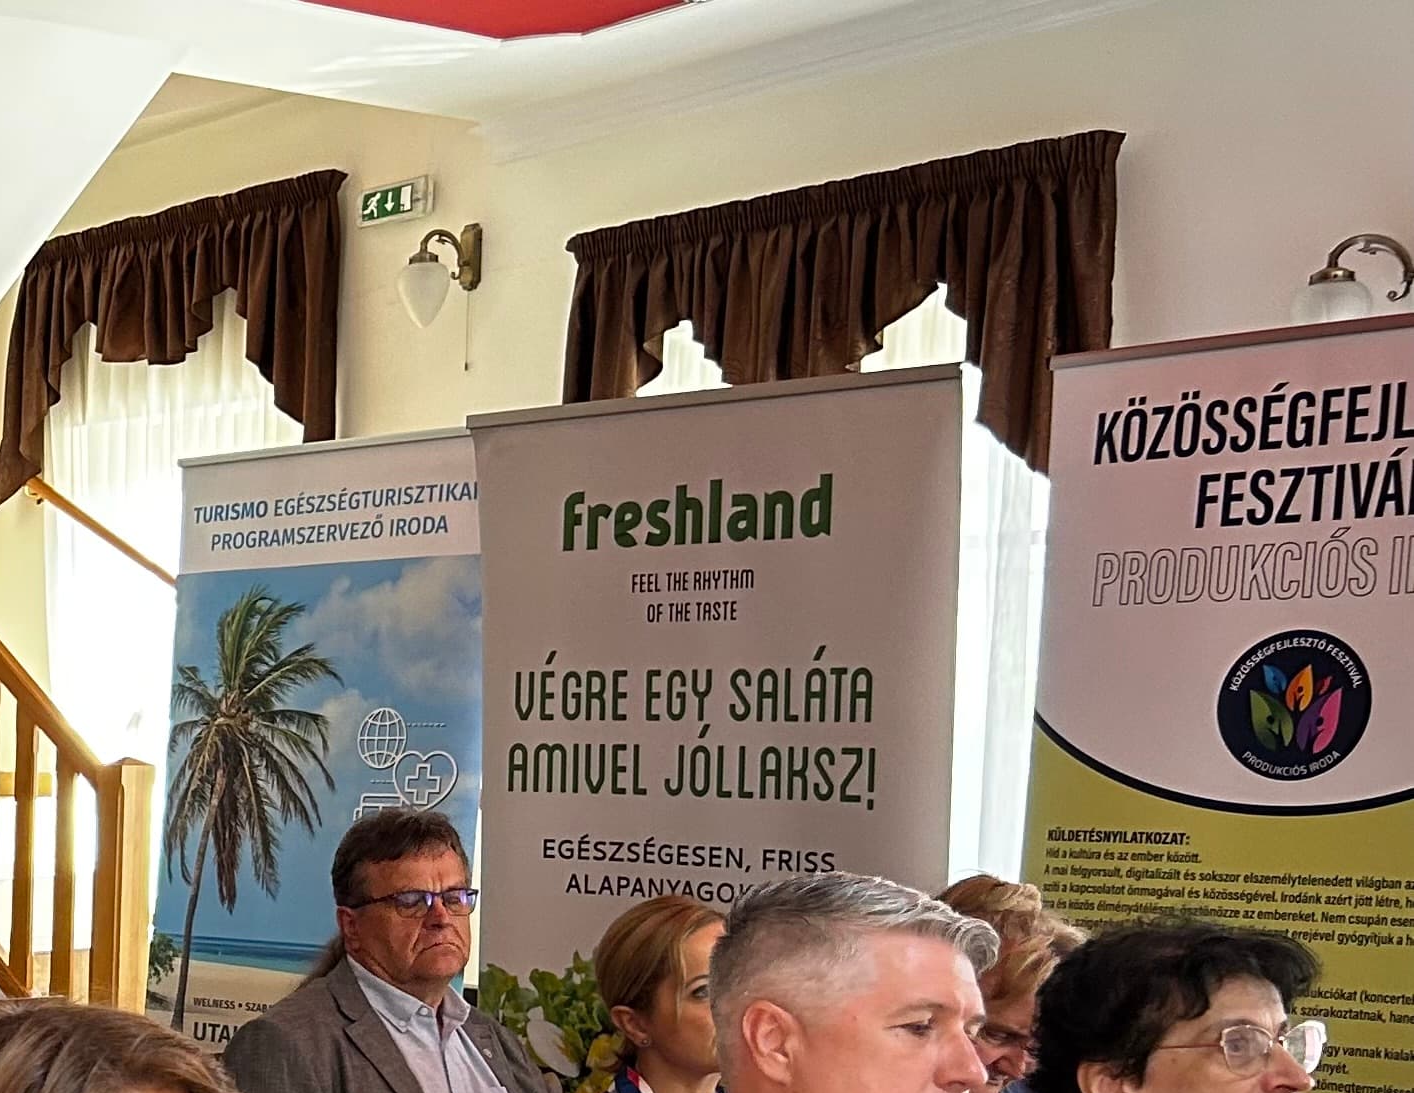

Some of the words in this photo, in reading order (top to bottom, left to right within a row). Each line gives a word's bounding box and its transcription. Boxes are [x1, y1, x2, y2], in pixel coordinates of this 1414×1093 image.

[194, 500, 268, 524] TURISMO
[273, 481, 478, 517] EGÉSZSÉGTURISZTIKAI
[562, 473, 833, 552] freshland
[211, 513, 384, 551] PROGRAMSZERVEZŐ
[389, 515, 449, 537] IRODA
[1092, 526, 1378, 607] PRODUKCIÓS
[631, 573, 661, 593] FEEL
[665, 571, 689, 591] THE
[693, 568, 755, 591] RHYTHM
[646, 604, 664, 623] OF
[668, 602, 691, 622] THE
[695, 600, 738, 621] TASTE
[1229, 636, 1328, 692] KÖZÖSSÉGFEJLESZTŐ
[1325, 643, 1363, 689] FESZTIVÁL
[514, 650, 628, 721] VÉGRE
[645, 668, 713, 721] EGY
[729, 645, 874, 722] SALÁTA
[507, 742, 648, 796] AMIVEL
[663, 723, 877, 811] JÓLLAKSZ!
[1241, 750, 1308, 777] PRODUKCIÓS
[1309, 750, 1342, 773] IRODA
[1047, 827, 1191, 845] KÜLDETÉSNYILATKOZAT:
[541, 834, 752, 873] EGÉSZSÉGESEN,
[761, 848, 836, 873] FRISS
[1103, 849, 1115, 860] és
[1116, 852, 1129, 860] az
[1130, 850, 1165, 863] ember
[1069, 882, 1125, 895] kapcsolatot
[1187, 886, 1200, 899] és
[1125, 866, 1181, 882] digitalizált
[1183, 870, 1196, 882] és
[1198, 872, 1241, 884] sokszor
[1243, 872, 1353, 888] elszemélytelenedett
[1355, 876, 1402, 891] világban
[1242, 910, 1255, 918] az
[1257, 910, 1319, 923] embereket.
[1321, 912, 1346, 923] Nem
[1348, 914, 1388, 928] csupán
[1396, 936, 1403, 945] a
[193, 1021, 238, 1043] UTA
[1342, 1046, 1382, 1059] vannak
